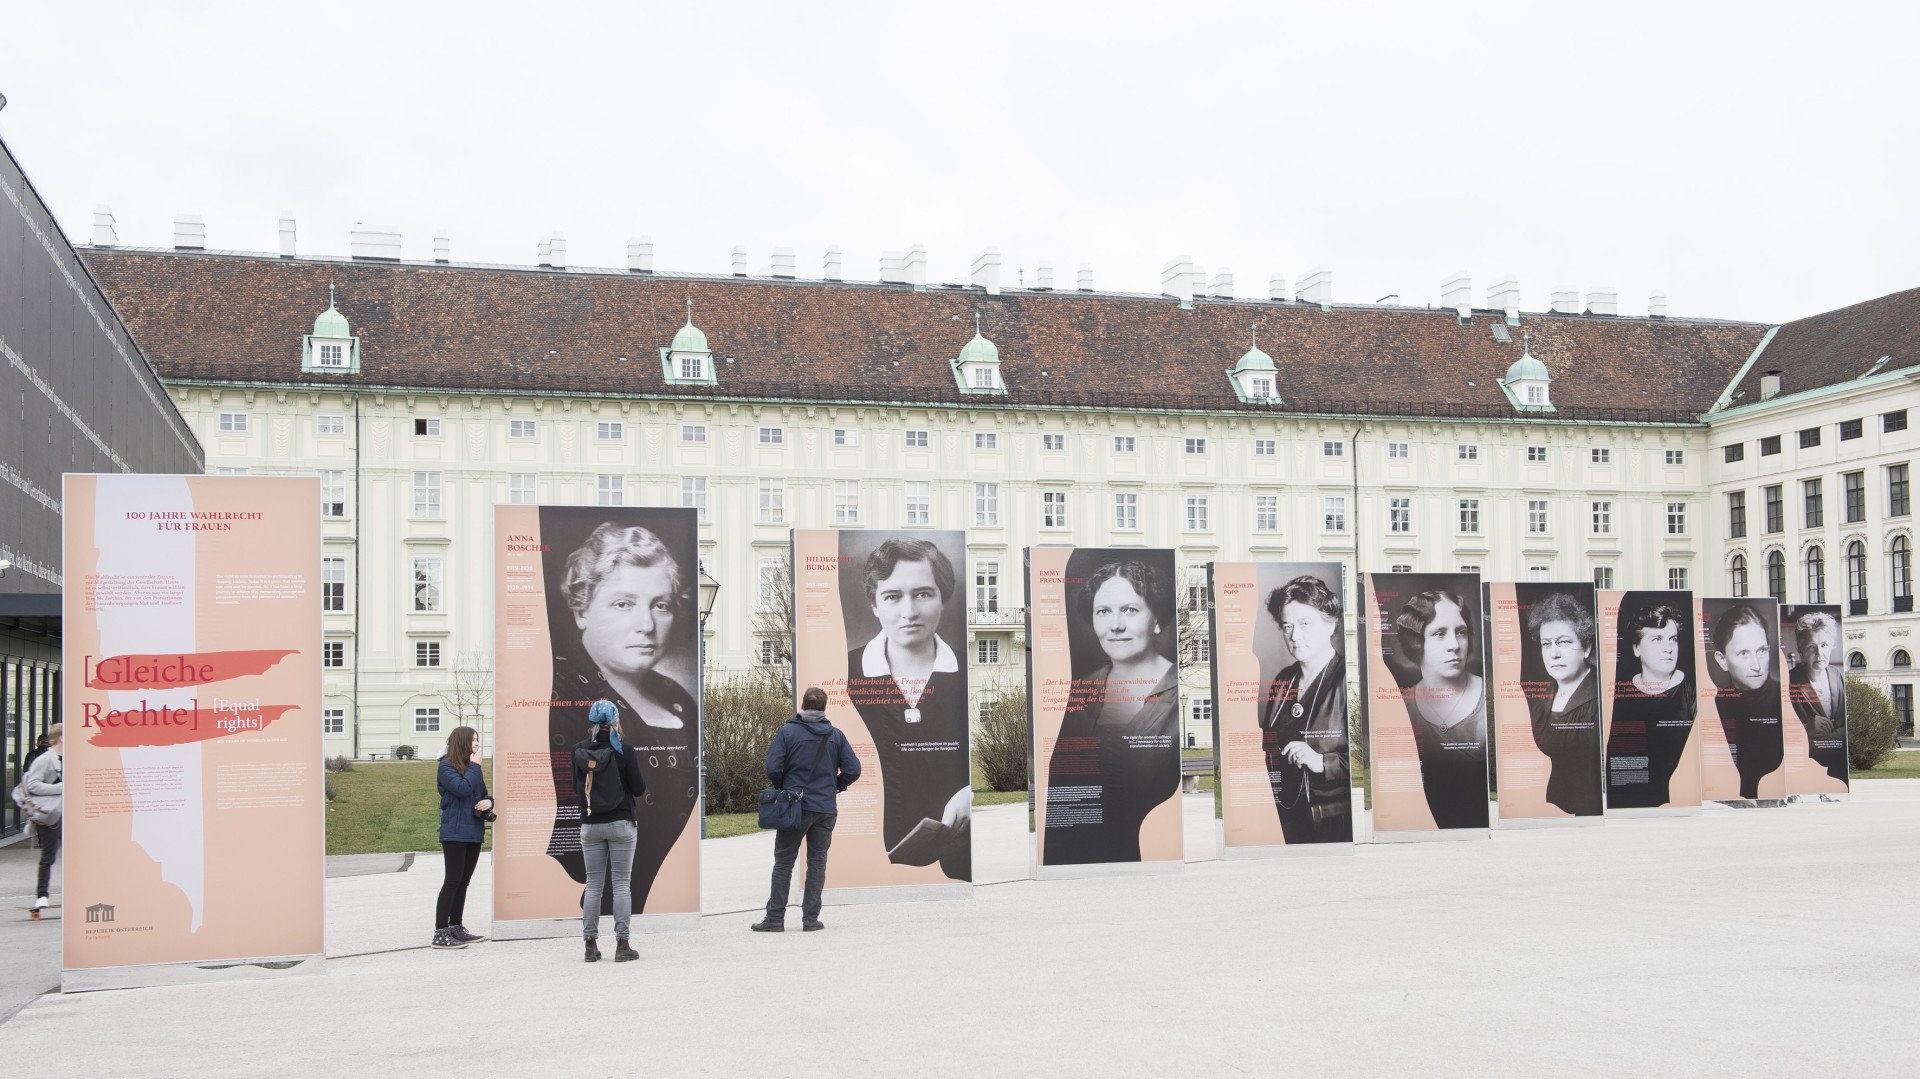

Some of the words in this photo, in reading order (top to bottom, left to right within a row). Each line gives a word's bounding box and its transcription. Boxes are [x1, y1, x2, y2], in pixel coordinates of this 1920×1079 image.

[126, 511, 146, 520] 100
[149, 511, 187, 521] JAHRE
[190, 511, 264, 520] WAHLRECHT
[158, 520, 182, 531] FÜR
[185, 522, 232, 531] FRAUEN
[84, 656, 214, 687] [Gleiche
[840, 688, 884, 696] öffentlichen
[505, 699, 572, 708] „Arbeiterinnen
[829, 698, 852, 707] länger
[81, 699, 198, 730] Rechte]
[213, 698, 260, 713] [Equal
[216, 715, 262, 733] rights]
